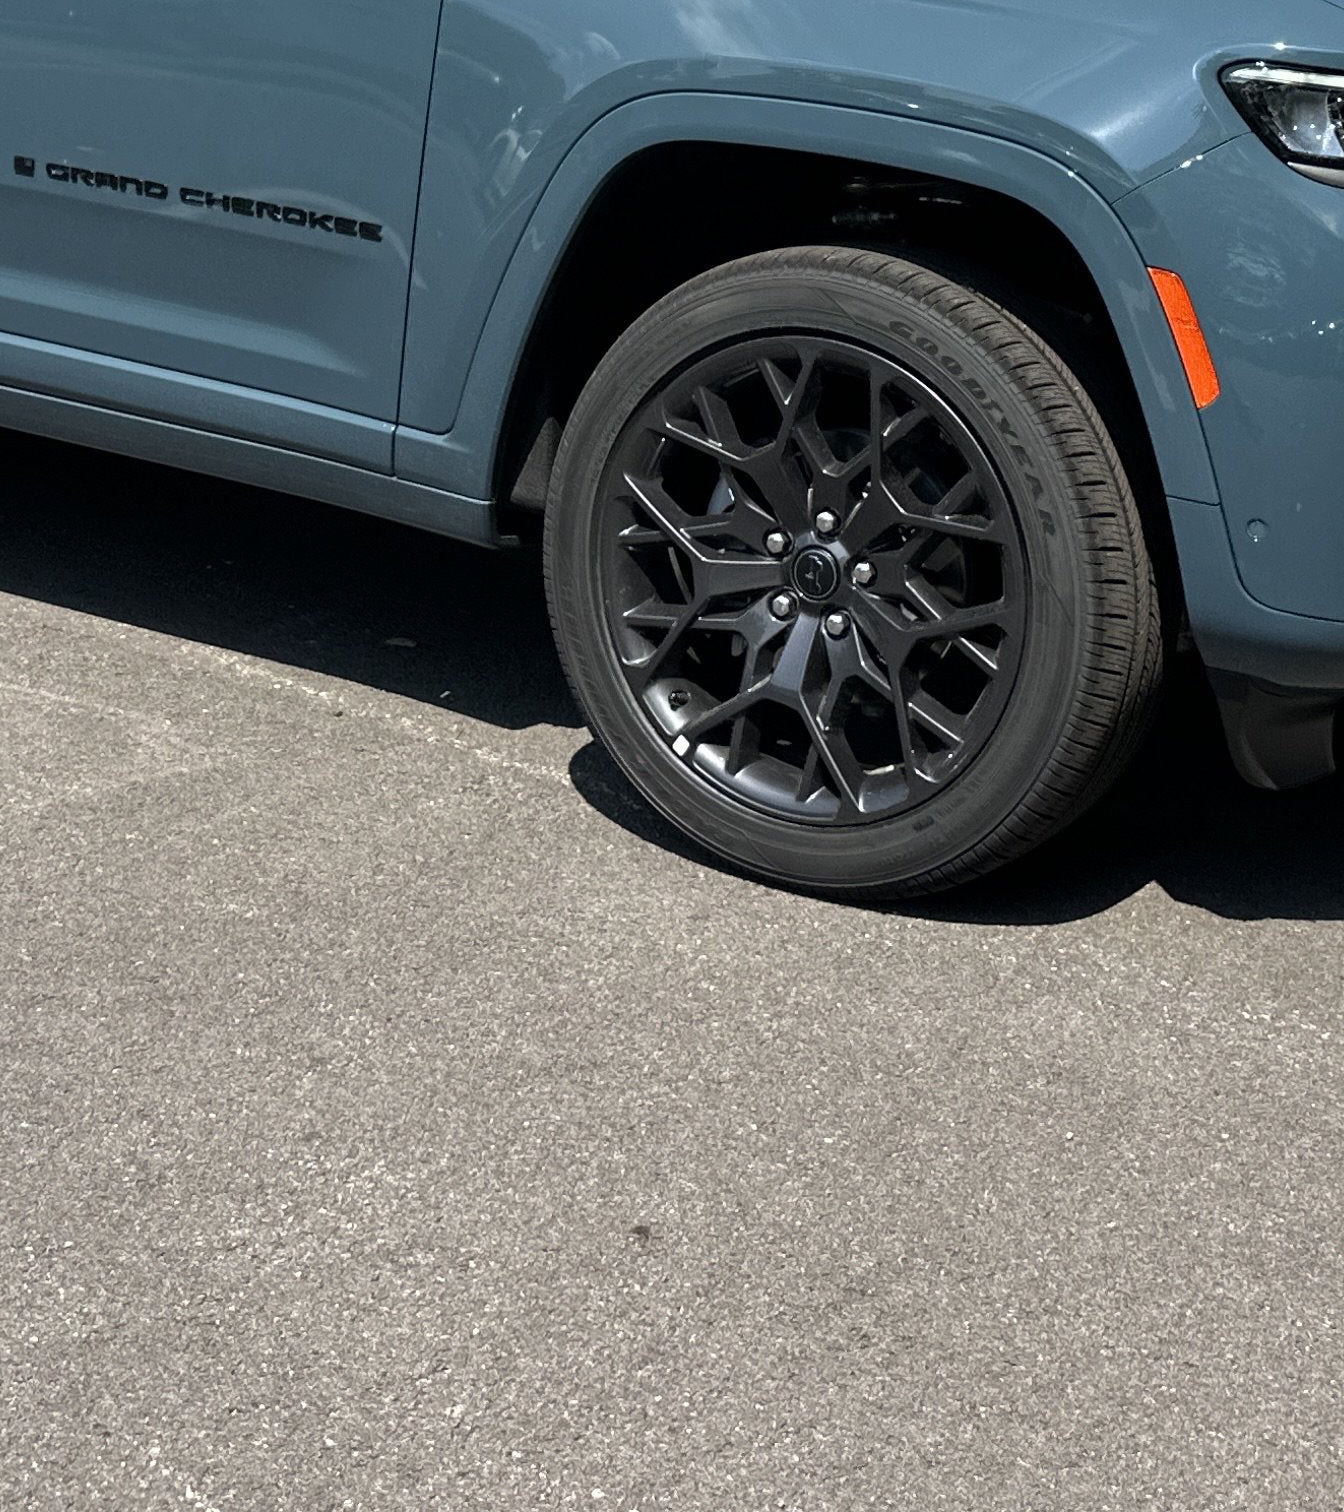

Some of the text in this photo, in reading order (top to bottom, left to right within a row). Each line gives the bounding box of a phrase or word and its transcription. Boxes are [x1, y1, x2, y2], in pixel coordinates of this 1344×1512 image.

[46, 162, 383, 243] GRAND CHEROKEE
[887, 320, 1056, 537] GOODYEAR
